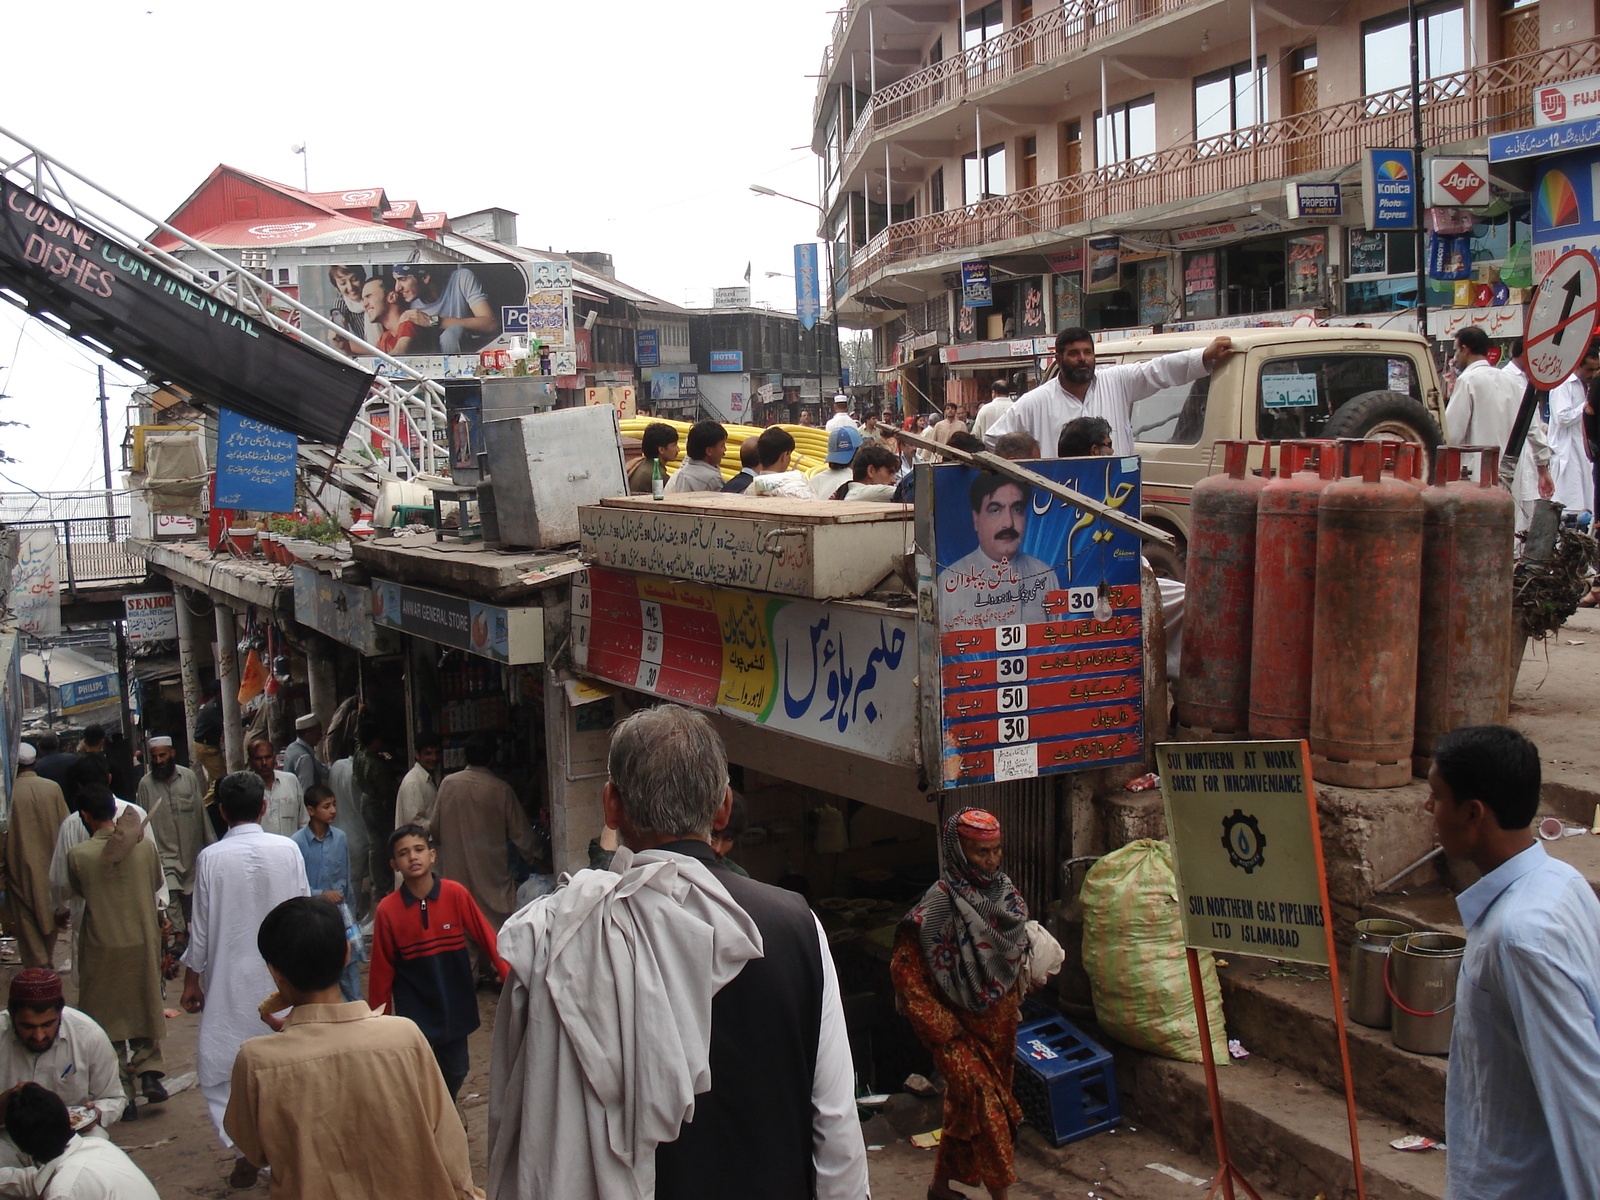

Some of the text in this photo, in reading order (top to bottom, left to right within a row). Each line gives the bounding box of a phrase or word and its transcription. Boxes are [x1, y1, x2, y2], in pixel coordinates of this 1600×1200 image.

[1550, 133, 1560, 147] 12
[1377, 183, 1410, 194] Konica
[1443, 173, 1480, 190] Agfa
[1301, 199, 1337, 207] PROPERTY
[1379, 199, 1401, 208] Photo
[1378, 210, 1407, 220] Express
[8, 191, 260, 338] CUISINE CONTINENTAL
[23, 233, 116, 298] DISHES
[1490, 309, 1516, 331] سیل
[681, 376, 696, 388] JIMS
[1265, 388, 1316, 406] انصاف
[680, 532, 687, 544] 30
[21, 541, 50, 565] سیل
[945, 557, 1018, 592] عاشق پہلوان
[128, 595, 174, 611] SENIOR
[1041, 593, 1067, 613] روپے
[1071, 592, 1094, 609] 30
[402, 601, 469, 631] ANWAR GENERAL STORE
[955, 637, 981, 653] روپے
[1001, 626, 1021, 646] 30
[783, 612, 853, 734] ہاؤس
[1000, 659, 1024, 676] 30
[646, 667, 657, 687] 30
[956, 668, 982, 686] روپے
[78, 681, 104, 694] PHILIPS
[1002, 688, 1023, 709] 50
[957, 700, 983, 716] روپے
[957, 709, 1128, 746] دال چاول 30 روپے
[960, 759, 986, 777] روپے
[1167, 750, 1297, 770] SUI NORTHERN AT WORK
[1171, 775, 1303, 793] SORRY FOR INNCONVENIANCE
[1189, 895, 1325, 927] SUI NORTHERN GAS PIPELINES
[1211, 922, 1300, 948] LTD ISLAMABAD
[1027, 1039, 1058, 1060] PEPSI
